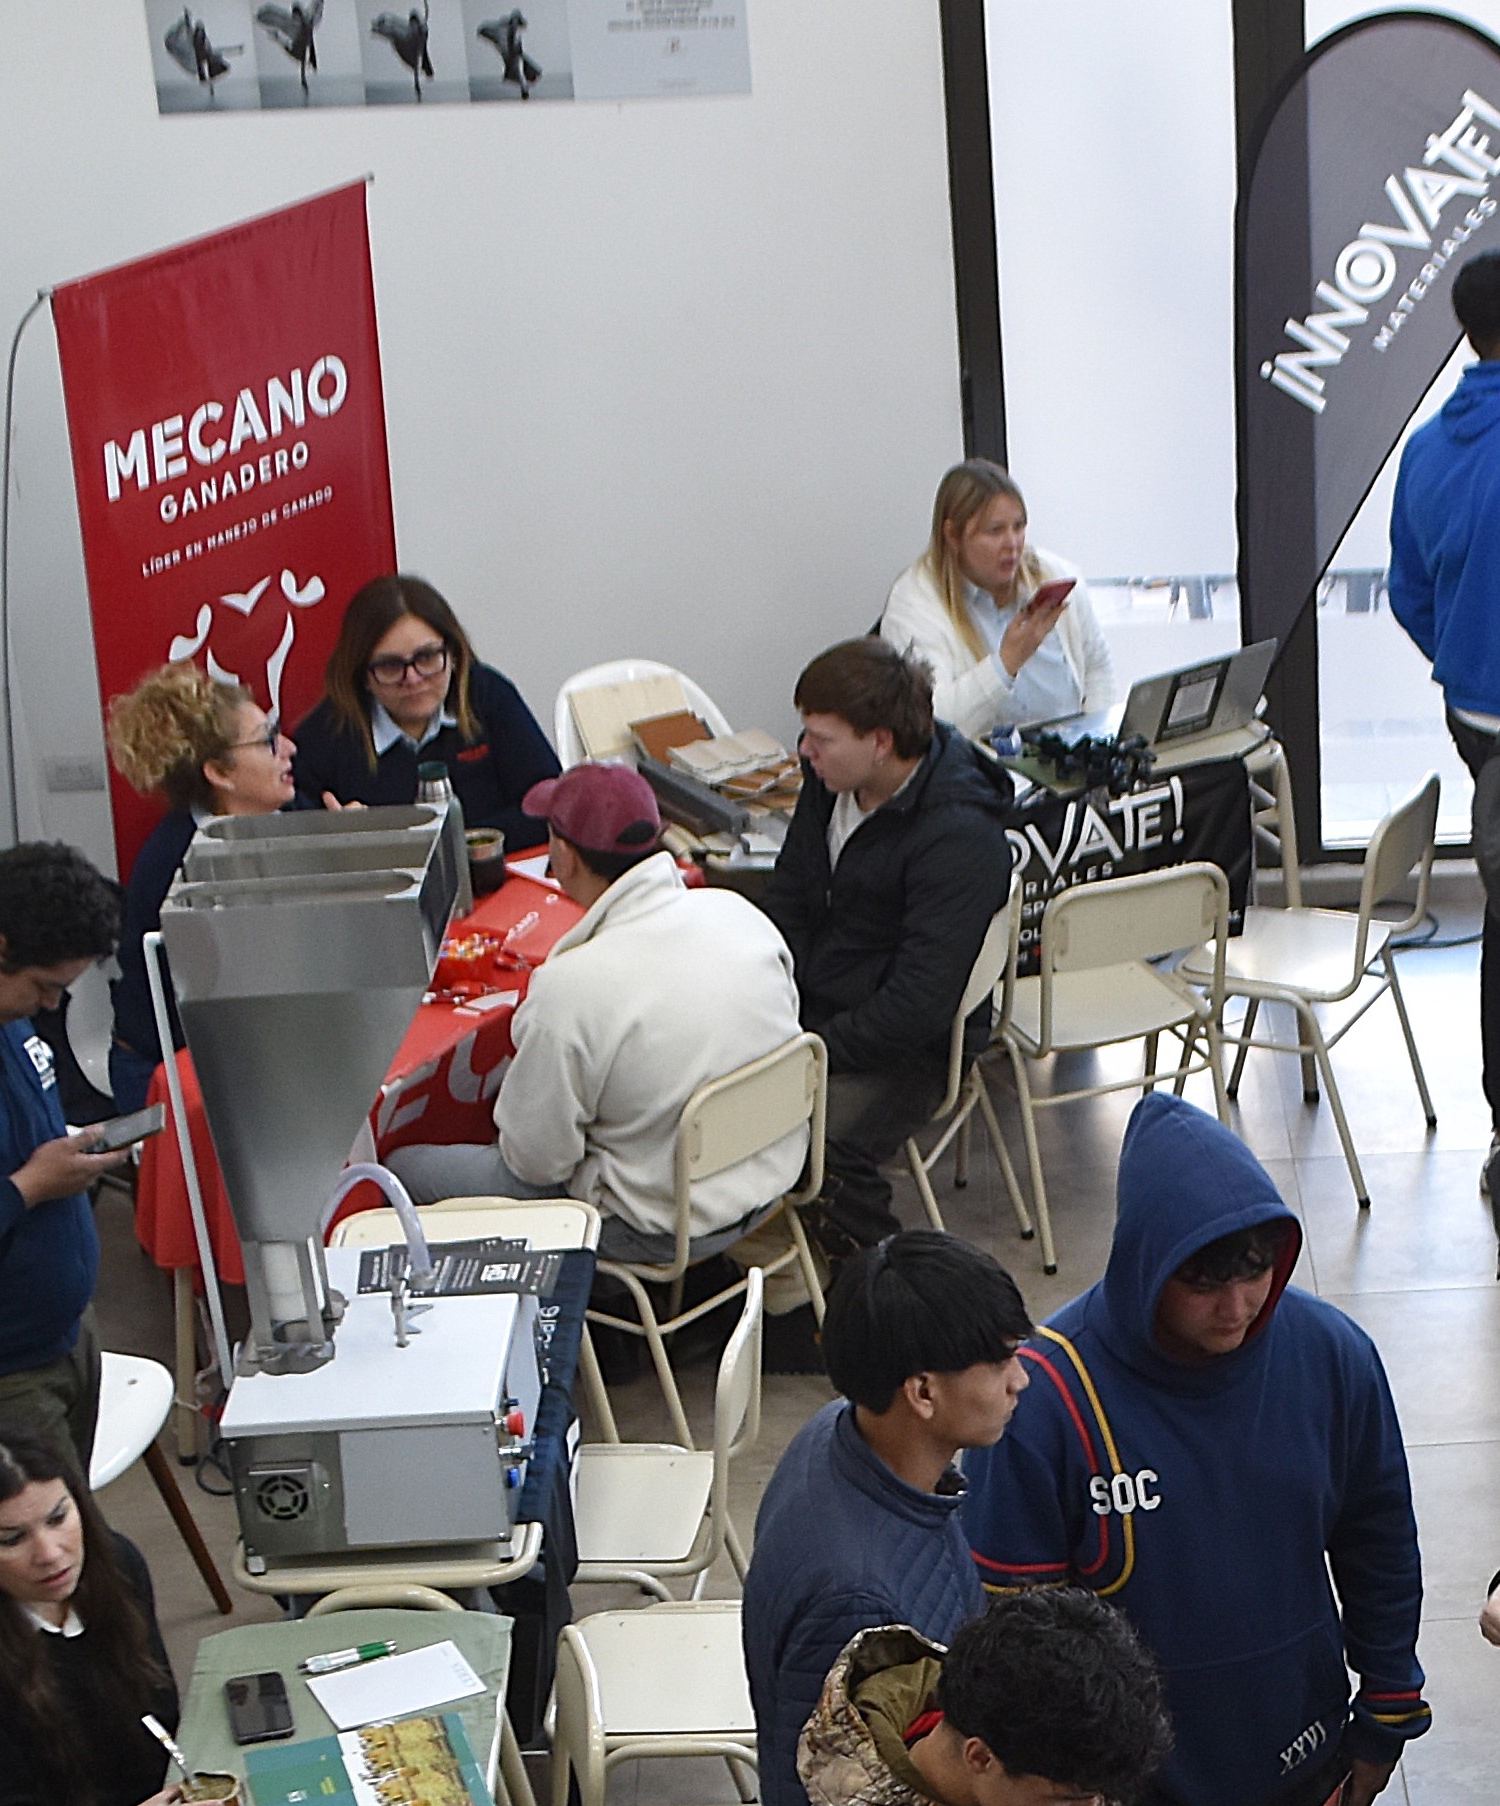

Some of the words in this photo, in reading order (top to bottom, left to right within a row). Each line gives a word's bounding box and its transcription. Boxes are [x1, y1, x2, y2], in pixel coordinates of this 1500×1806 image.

[1373, 198, 1498, 352] MATERIALES
[103, 355, 347, 502] MECANO
[160, 440, 309, 523] GANADERO
[142, 548, 181, 578] LÍDER
[186, 540, 202, 559] EN
[207, 518, 257, 552] MANEJO
[262, 508, 278, 528] DE
[282, 485, 333, 518] GANADO
[1090, 1469, 1161, 1516] SOC
